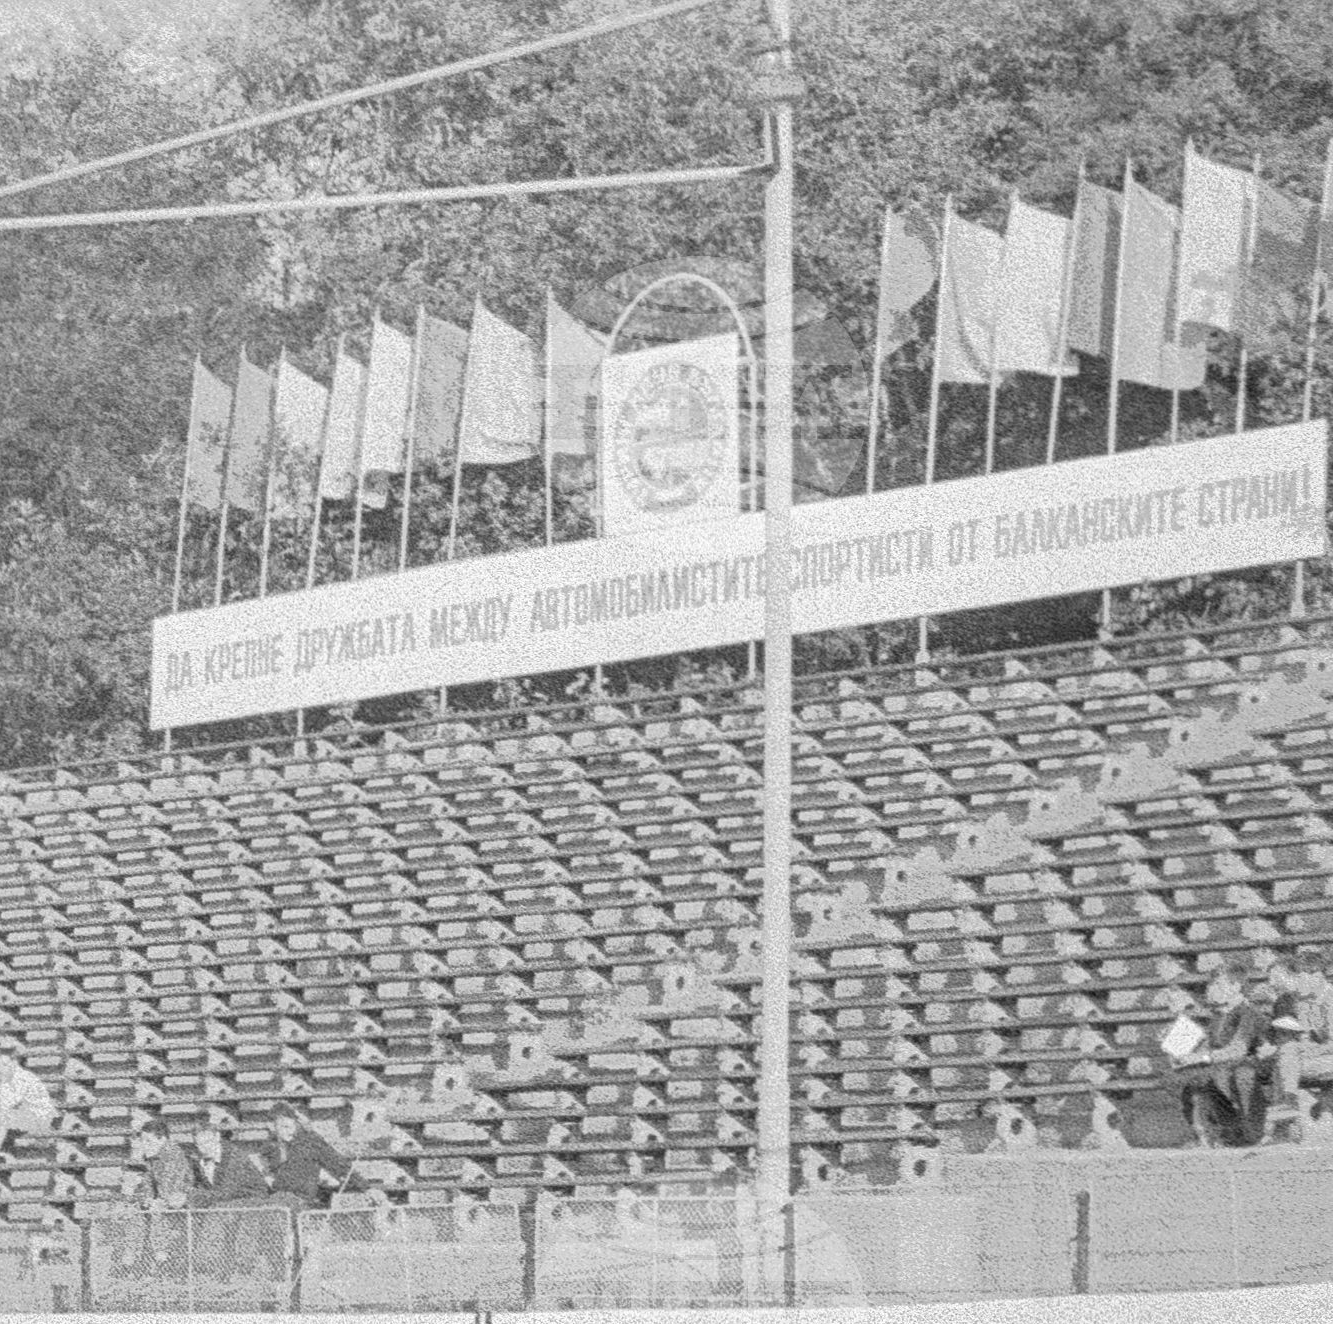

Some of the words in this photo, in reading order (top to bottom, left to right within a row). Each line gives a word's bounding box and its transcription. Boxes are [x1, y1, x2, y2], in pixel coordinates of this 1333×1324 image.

[166, 651, 194, 697] ДА
[204, 633, 284, 686] КРЕПНЕ
[293, 613, 416, 676] ДРУЖБАТА
[429, 593, 513, 649] МЕЖДУ
[947, 519, 981, 568] ОТ
[994, 488, 1187, 558] БАЛКАНСКИТЕ
